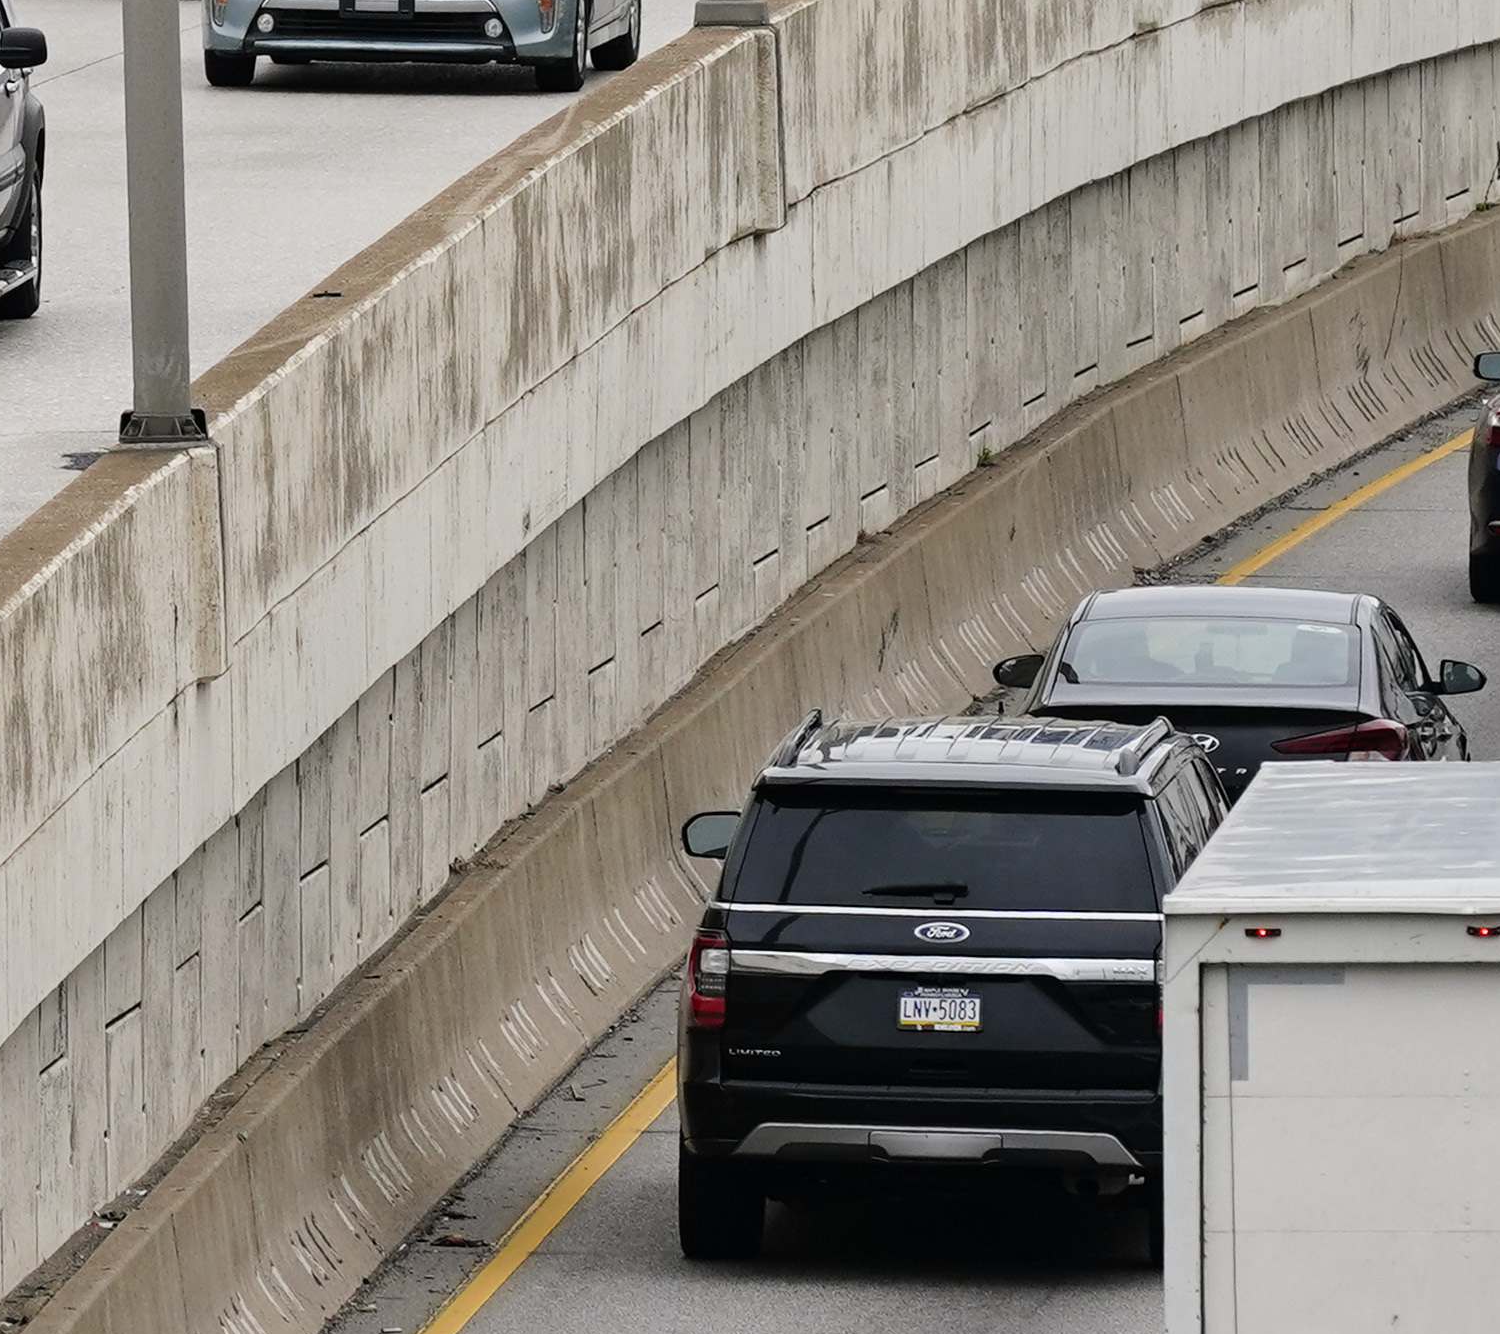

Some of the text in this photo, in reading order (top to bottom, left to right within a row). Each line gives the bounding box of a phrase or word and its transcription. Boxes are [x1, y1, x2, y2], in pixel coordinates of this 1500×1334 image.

[846, 958, 1149, 976] EXPEDITION MAX
[728, 1048, 782, 1057] LIMITED
